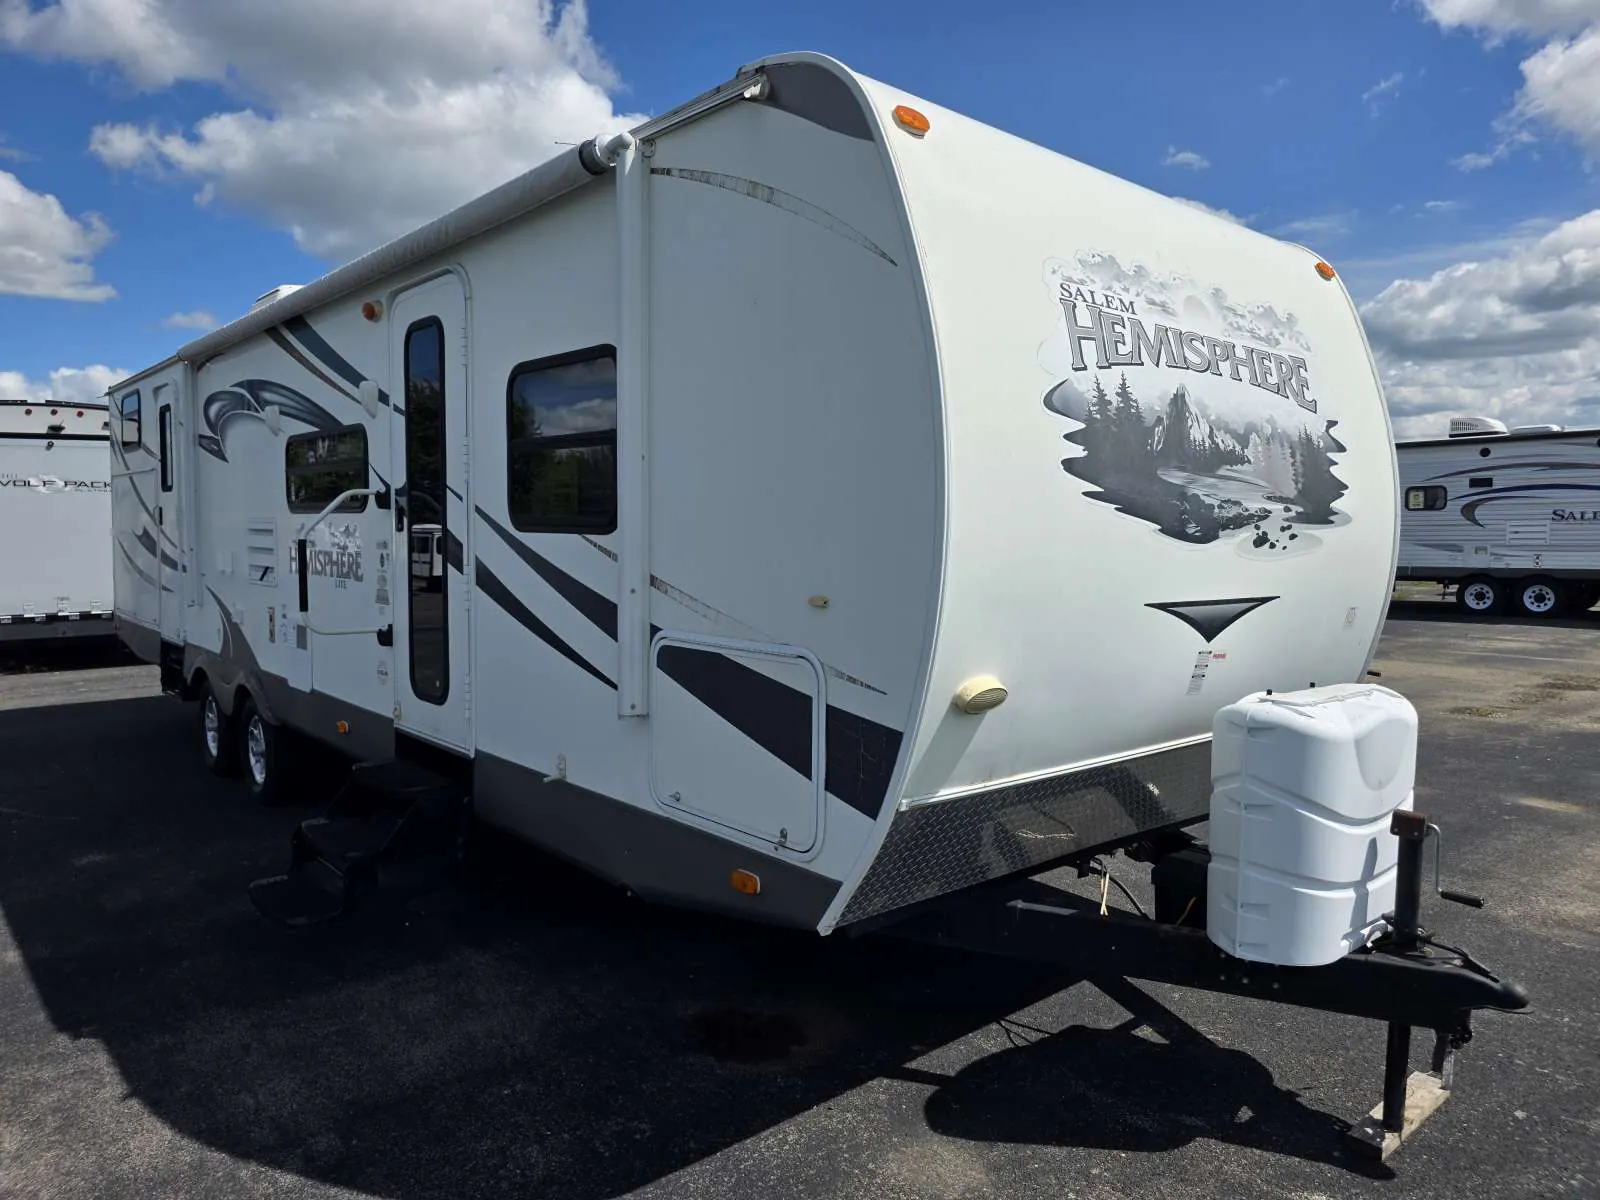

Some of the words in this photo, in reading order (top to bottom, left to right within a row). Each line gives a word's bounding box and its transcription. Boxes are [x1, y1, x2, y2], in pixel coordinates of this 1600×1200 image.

[1059, 282, 1138, 316] SALEM
[1059, 297, 1318, 415] HEMISPHERE
[289, 546, 364, 583] HISPHERE
